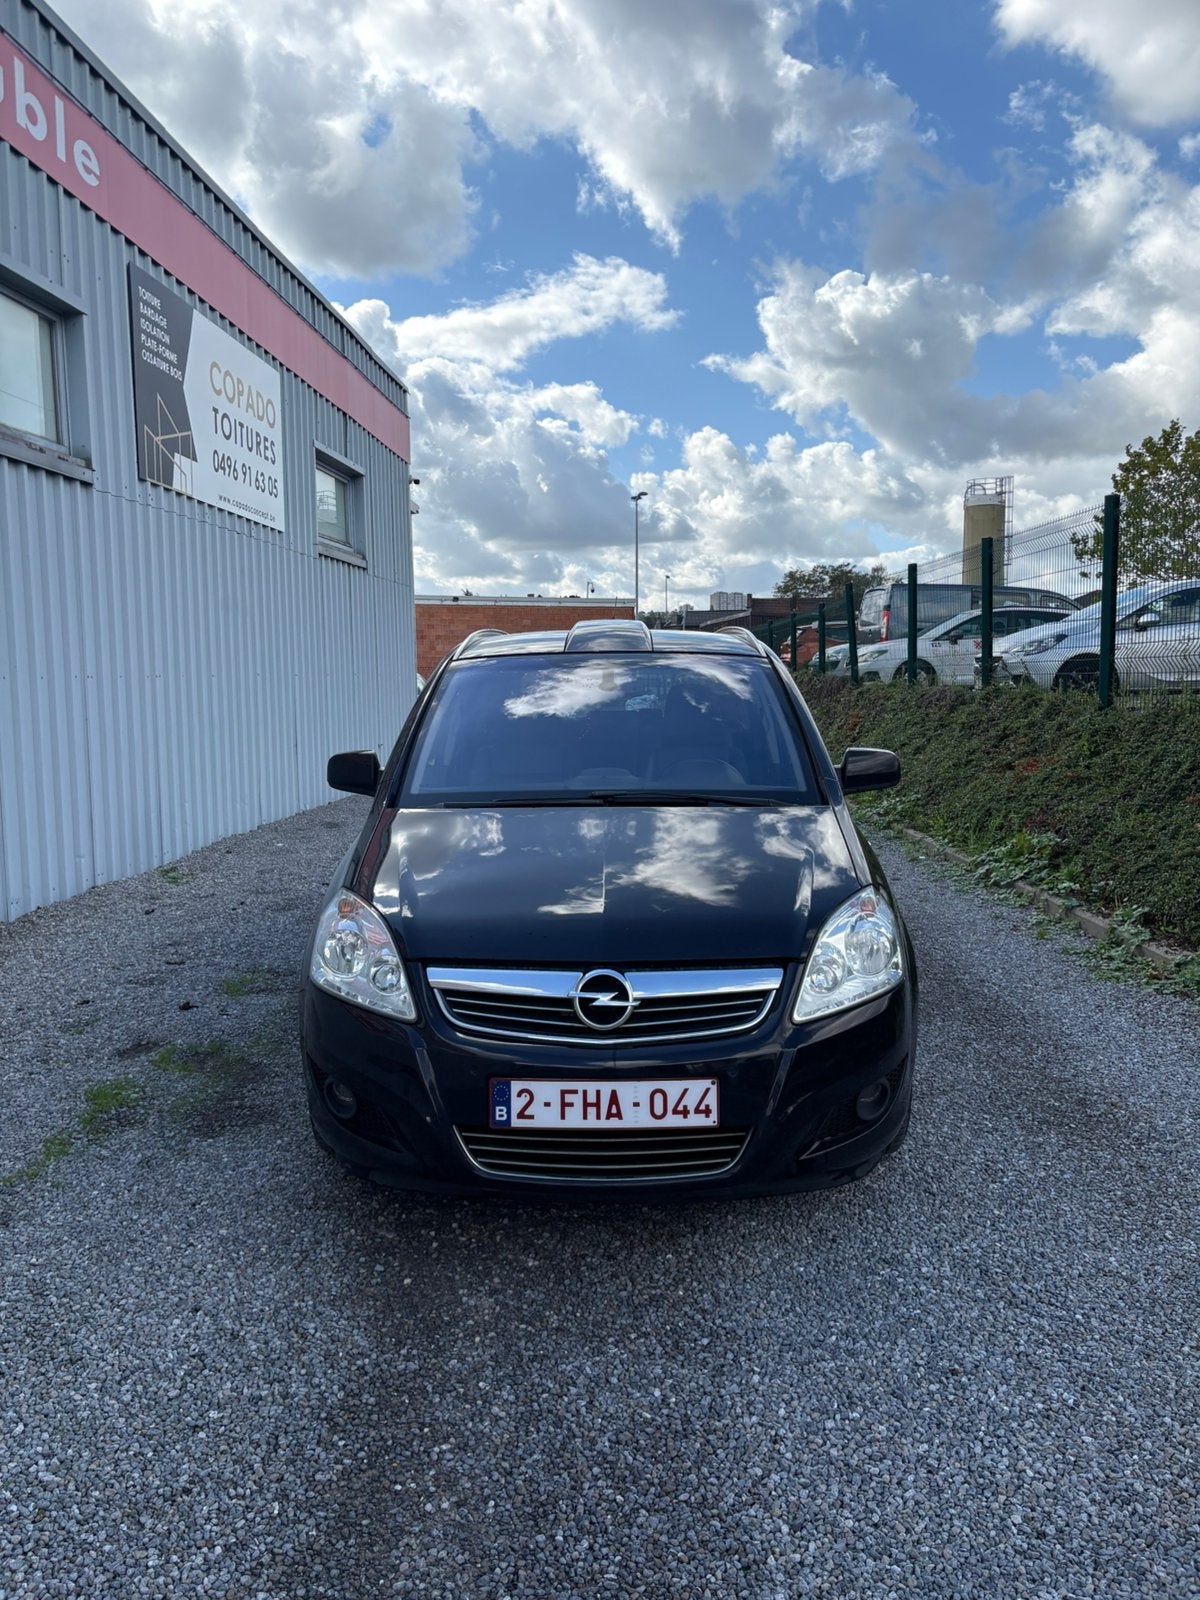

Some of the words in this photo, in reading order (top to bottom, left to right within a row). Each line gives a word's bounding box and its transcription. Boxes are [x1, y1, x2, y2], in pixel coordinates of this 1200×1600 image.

[0, 56, 100, 187] ble
[138, 286, 161, 310] TOITURE
[140, 302, 167, 329] BARDAGE
[140, 317, 170, 345] ISOLATION
[141, 333, 178, 364] PLATE-FORME
[142, 349, 169, 374] OSSATURE
[170, 366, 183, 381] BOIS
[209, 361, 276, 429] COPADO
[212, 406, 276, 465] TOITURES
[212, 449, 239, 481] 0496
[241, 463, 252, 487] 91
[254, 470, 266, 493] 63
[267, 476, 279, 498] 05
[495, 1106, 508, 1121] B
[516, 1087, 712, 1121] 2-FHA-044
